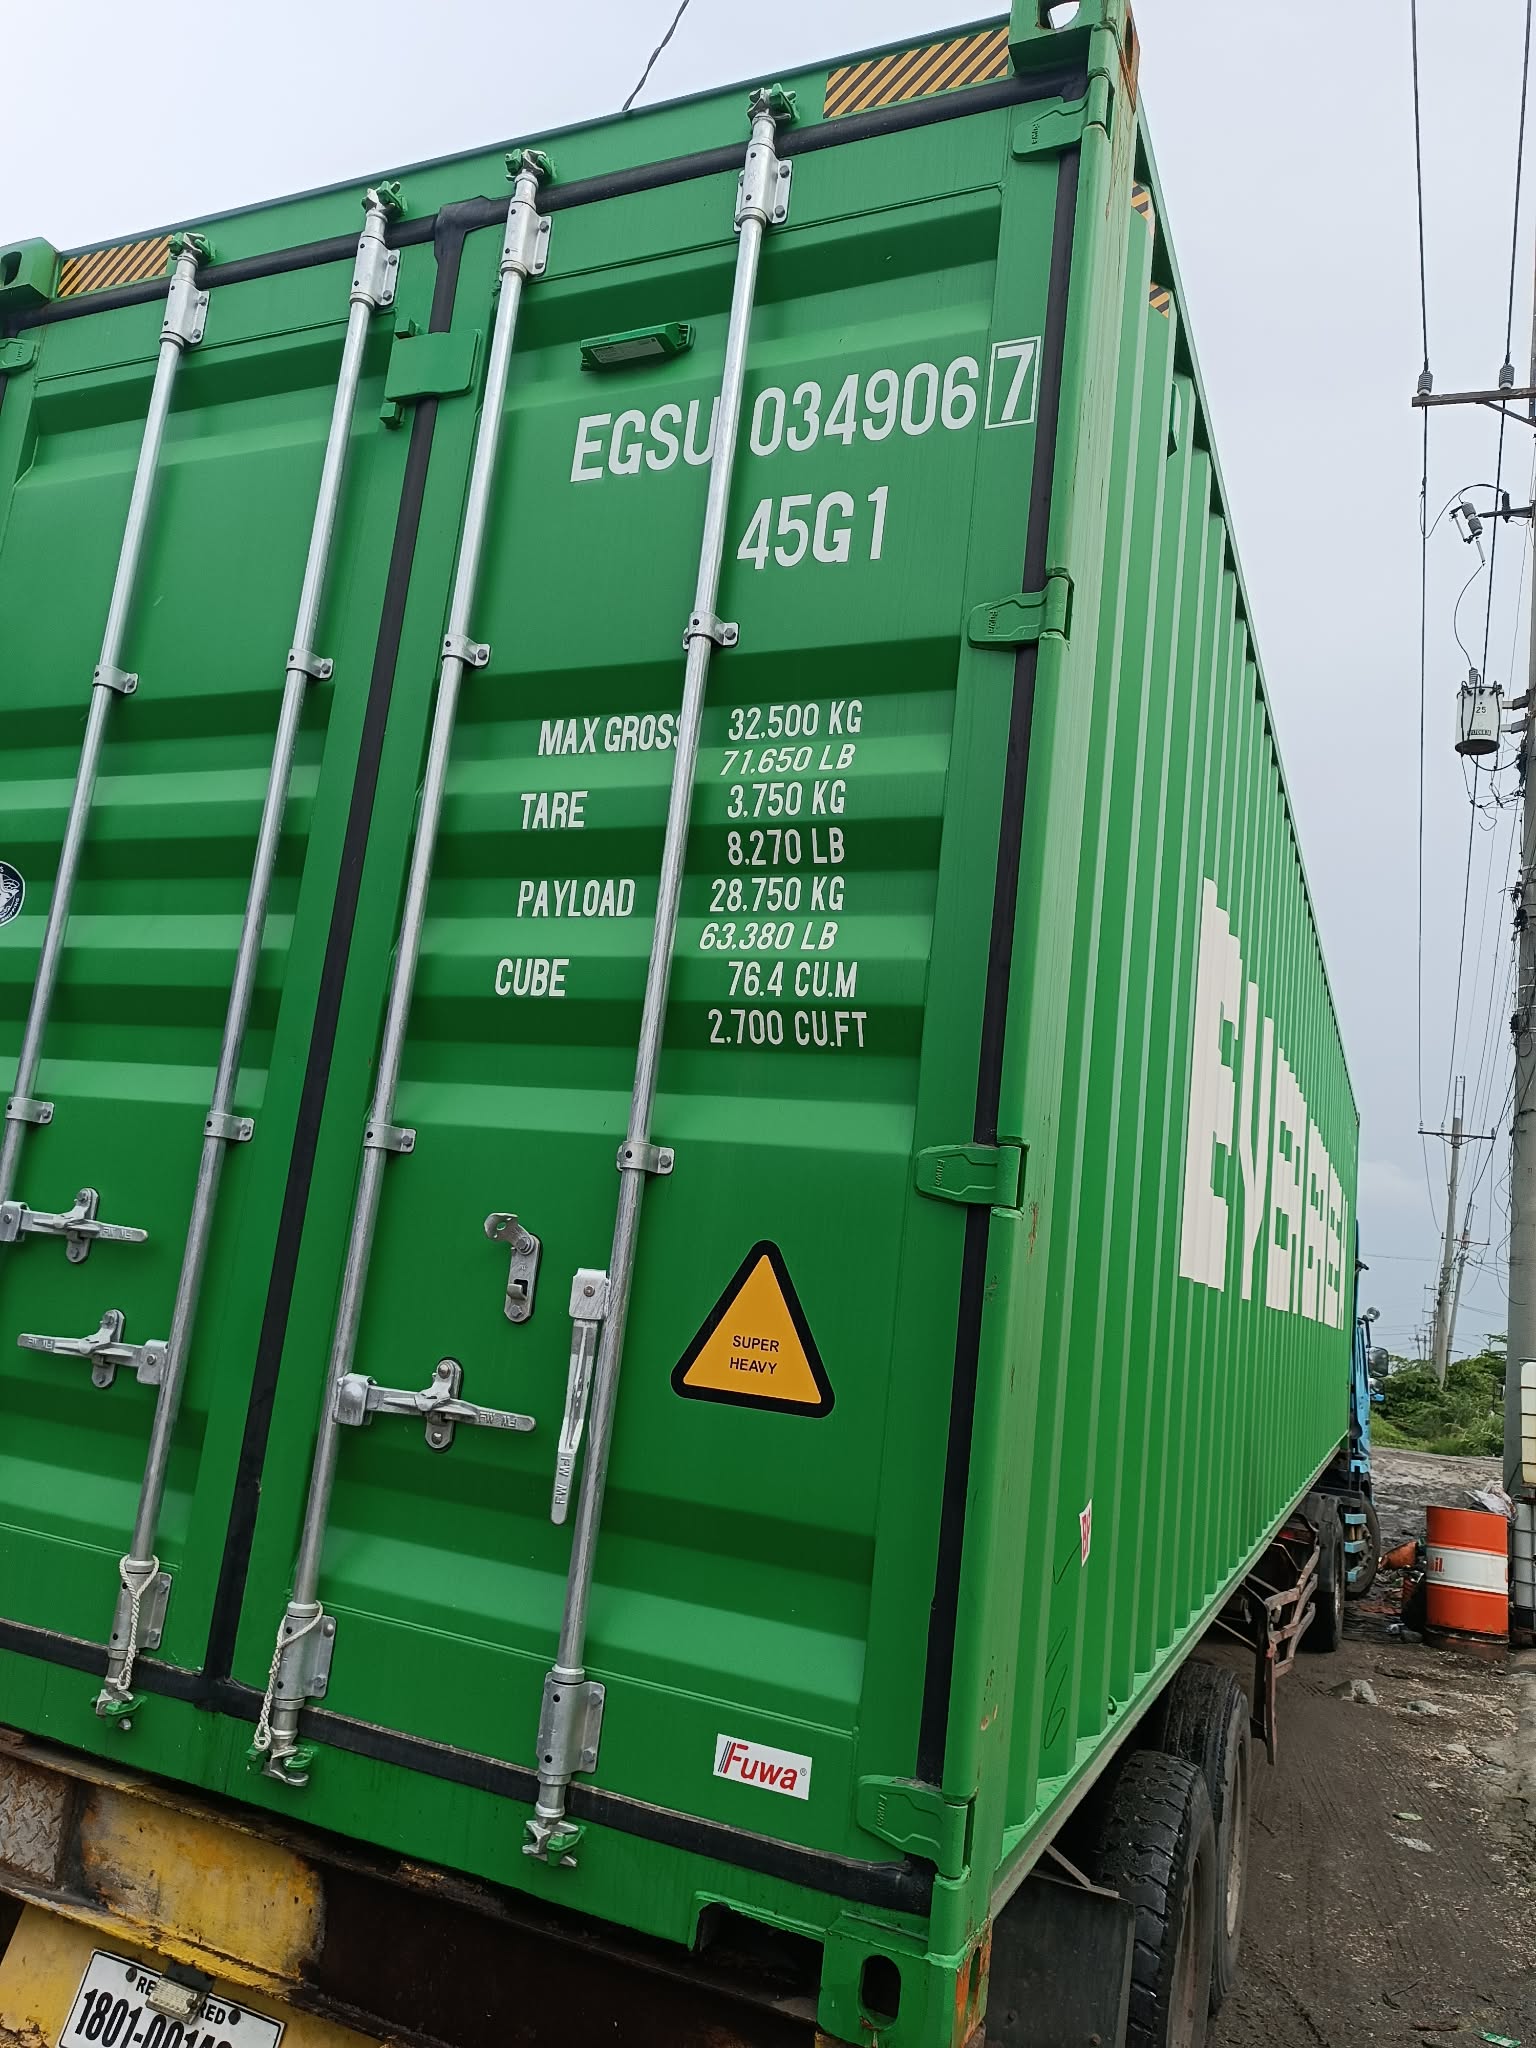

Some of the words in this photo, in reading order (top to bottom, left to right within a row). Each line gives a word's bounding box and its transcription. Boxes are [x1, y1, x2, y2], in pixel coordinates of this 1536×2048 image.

[570, 393, 720, 482] EGSU
[749, 356, 979, 456] 034906
[736, 485, 889, 570] 45G1
[537, 717, 600, 756] MAX
[828, 700, 863, 735] KG
[1475, 706, 1487, 714] 25
[818, 744, 856, 771] LB
[520, 790, 588, 830] TARE
[811, 780, 846, 815] KG
[811, 827, 845, 864] LB
[516, 878, 636, 917] PAYLOAD
[810, 875, 845, 911] KG
[800, 921, 839, 950] LB
[494, 958, 570, 997] CUBE
[728, 961, 784, 997] 76.4
[794, 961, 858, 998] CU.M
[794, 1010, 867, 1048] CU.FT
[732, 1334, 780, 1353] SUPER
[729, 1356, 778, 1375] HEAVY
[723, 1742, 798, 1791] Fuwa
